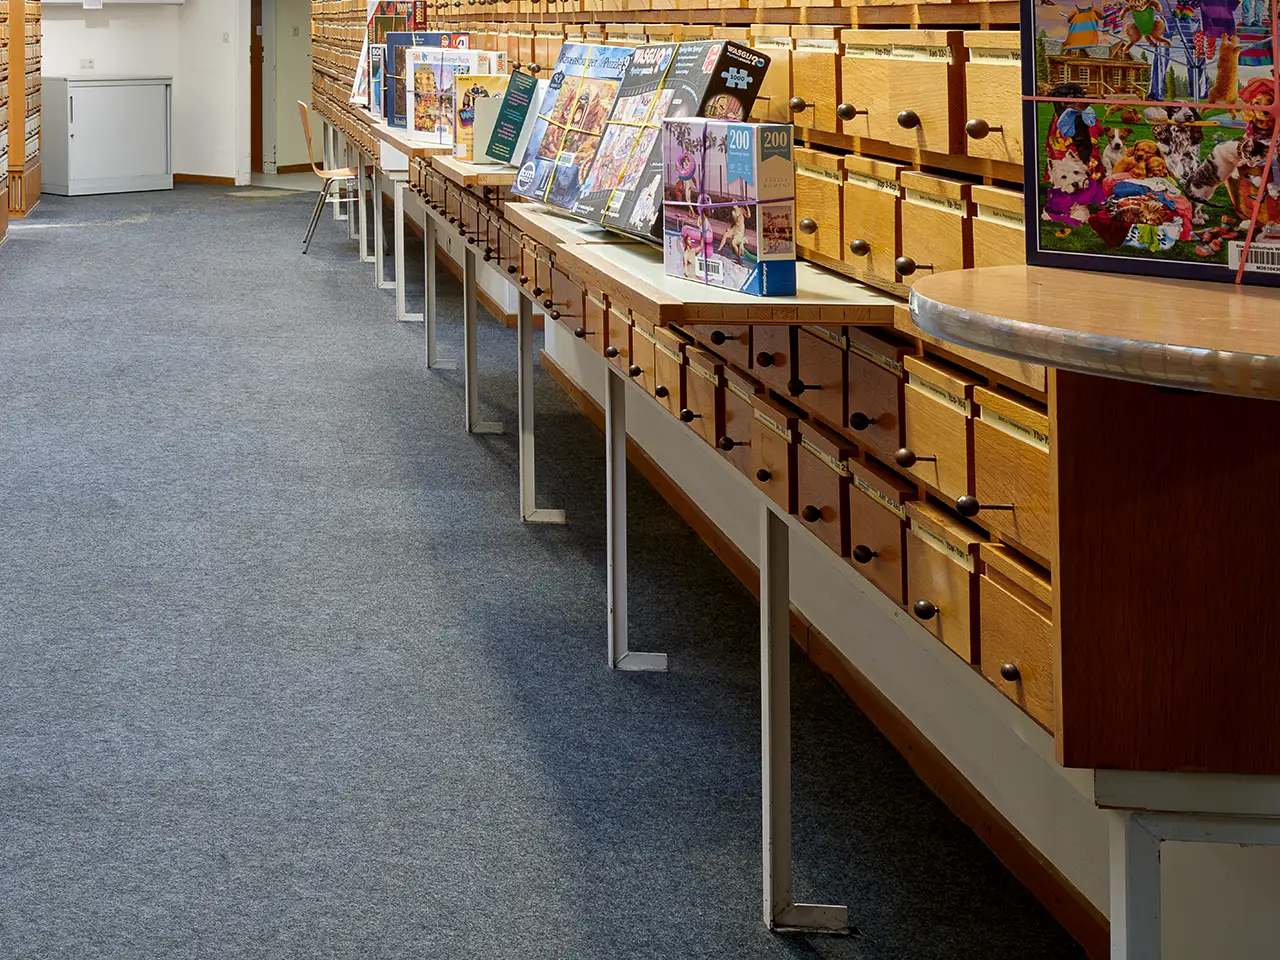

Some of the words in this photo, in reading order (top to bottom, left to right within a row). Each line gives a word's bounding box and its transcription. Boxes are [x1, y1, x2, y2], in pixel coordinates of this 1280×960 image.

[559, 52, 599, 69] Ravensburger
[730, 74, 745, 82] 1000
[729, 129, 750, 150] 200
[763, 131, 788, 148] 200
[1236, 243, 1274, 251] Stabibliothek
